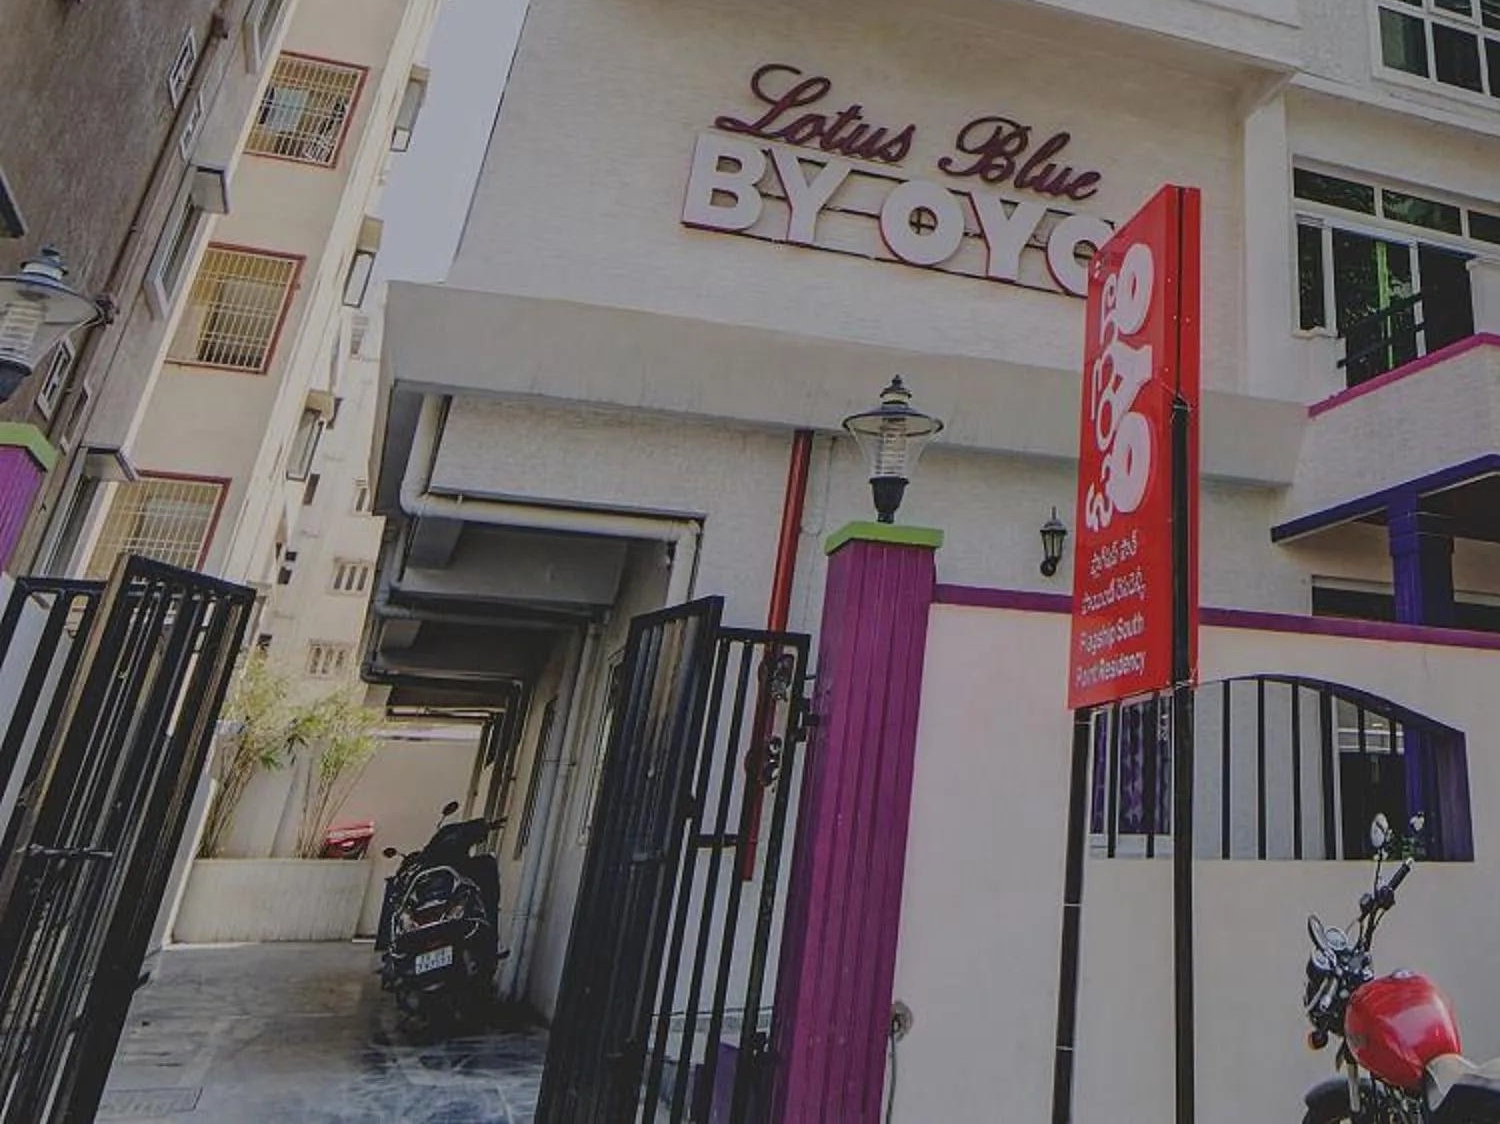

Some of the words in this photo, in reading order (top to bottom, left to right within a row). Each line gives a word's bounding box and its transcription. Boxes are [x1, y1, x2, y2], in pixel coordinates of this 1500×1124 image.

[681, 127, 852, 246] BY
[714, 63, 917, 164] Lotus
[937, 115, 1102, 201] Blue
[1101, 242, 1154, 514] OYO
[1080, 622, 1115, 656] Flagship
[1116, 611, 1145, 641] South
[1099, 651, 1147, 681] Residency
